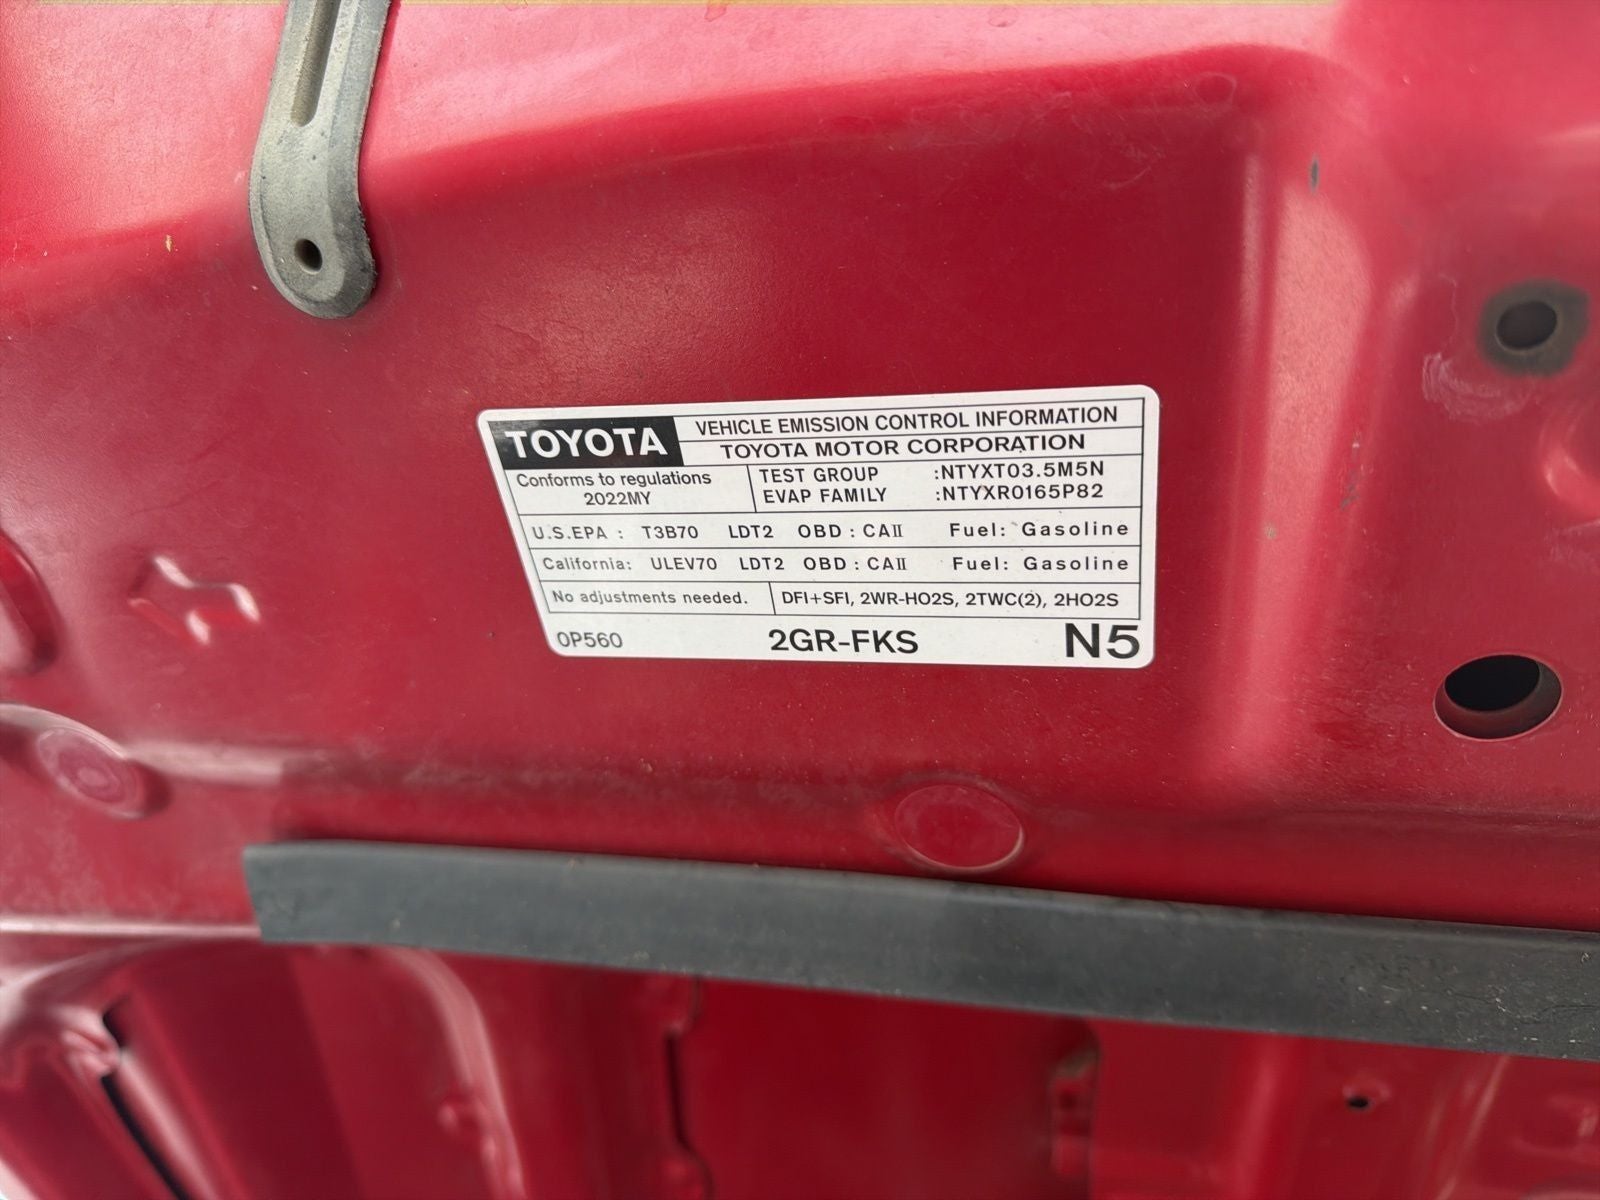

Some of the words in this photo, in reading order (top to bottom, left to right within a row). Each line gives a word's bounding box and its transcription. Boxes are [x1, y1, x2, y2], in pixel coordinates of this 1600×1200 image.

[694, 418, 774, 437] VEHICLE
[777, 415, 870, 434] EMISSION
[874, 411, 970, 431] CONTROL
[975, 405, 1118, 428] INFORMATION
[503, 426, 669, 460] TOYOTA
[719, 442, 809, 460] TOYOTA
[814, 439, 900, 457] MOTOR
[906, 433, 1085, 455] CORPORATION
[516, 472, 595, 488] Conforms
[597, 472, 616, 487] to
[619, 470, 712, 488] regulations
[758, 467, 806, 484] TEST
[813, 466, 879, 483] GROUP
[934, 460, 1104, 481] :NTYXT03.5M5N
[583, 490, 651, 506] 2022MY
[762, 488, 812, 504] EVAP
[819, 487, 887, 504] FAMILY
[935, 482, 1104, 502] :NTYXR0165P82
[531, 525, 608, 540] U.S.EPA
[640, 525, 699, 540] T3B70
[727, 524, 775, 539] LDT2
[797, 523, 842, 539] OBD
[949, 521, 1006, 538] Fuel:
[1021, 520, 1129, 537] Gasoline
[542, 556, 632, 571] California:
[650, 556, 718, 571] ULEV70
[738, 556, 785, 571] LDT2
[803, 556, 847, 571] OBD
[952, 556, 1009, 571] Fuel:
[1023, 555, 1129, 571] Gasoline
[551, 590, 574, 603] No
[579, 590, 677, 605] adjustments
[682, 591, 748, 605] needed.
[781, 590, 855, 608] DFI+SFI,
[859, 591, 960, 608] 2WR-HO2S,
[965, 592, 1047, 609] 2TWC(2),
[1053, 592, 1120, 608] 2HO2S
[768, 627, 919, 655] 2GR-FKS
[1064, 622, 1141, 660] N5
